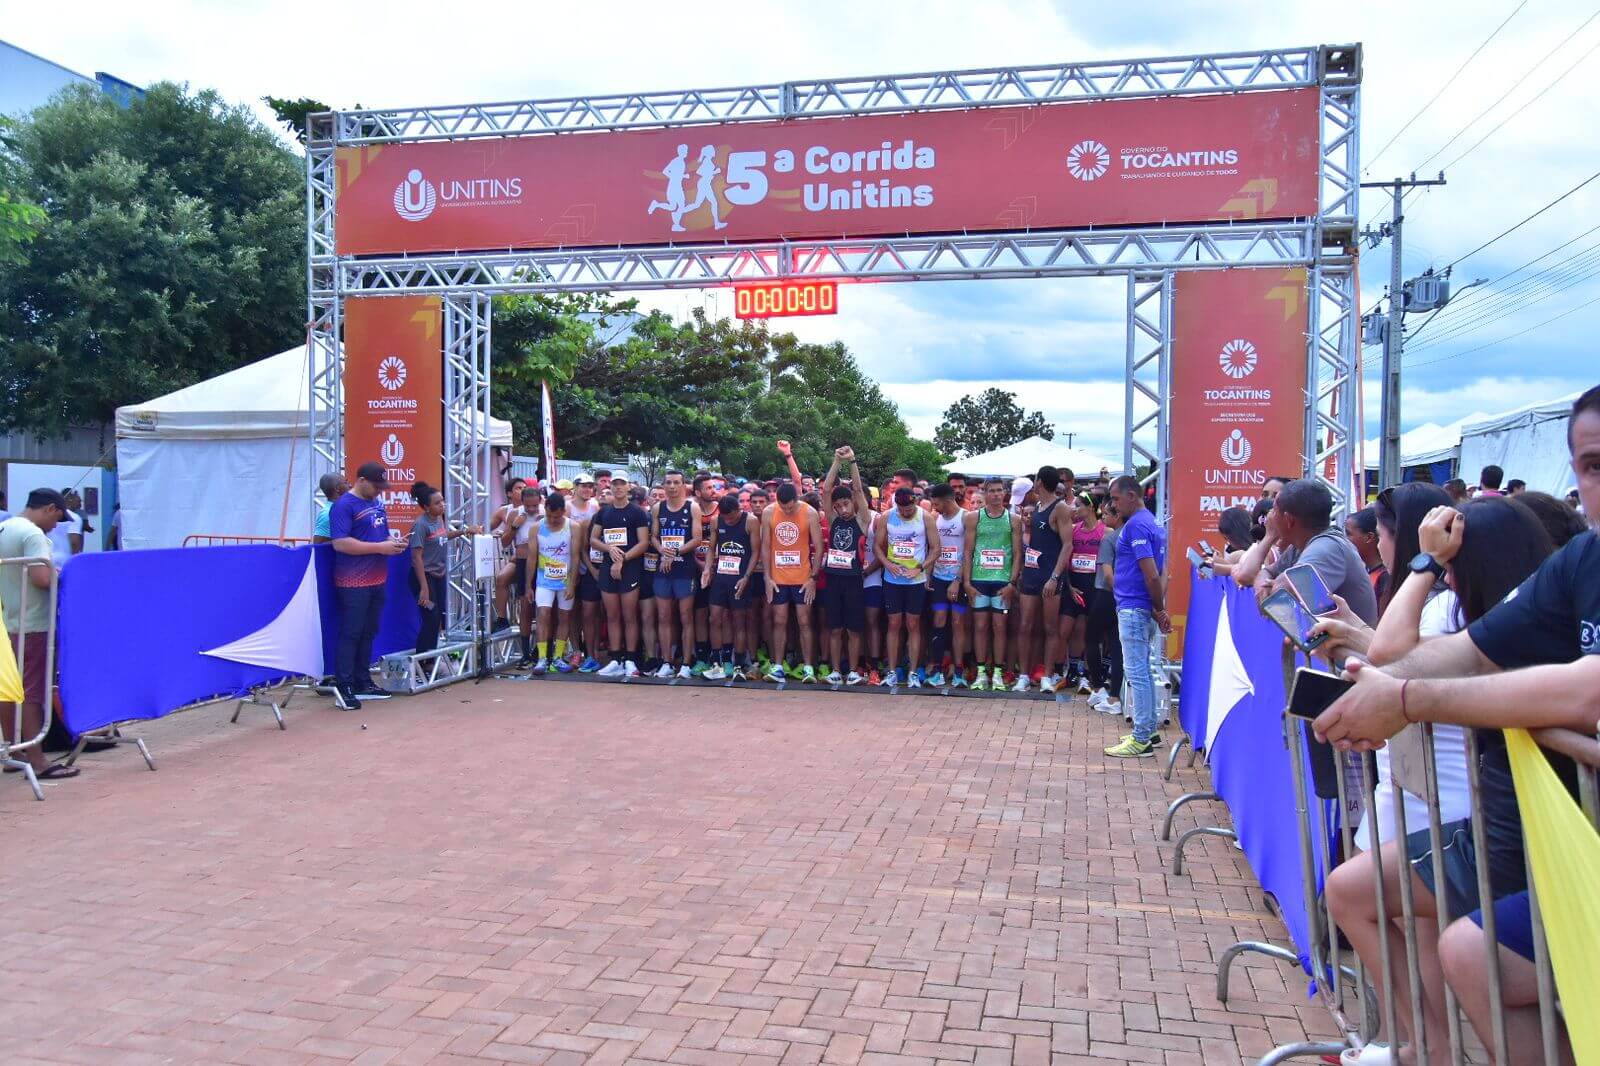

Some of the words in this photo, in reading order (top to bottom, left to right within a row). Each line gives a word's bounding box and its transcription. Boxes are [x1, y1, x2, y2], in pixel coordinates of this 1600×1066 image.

[804, 140, 935, 174] Corrida
[1121, 149, 1238, 169] TOCANTINS
[440, 177, 522, 200] UNITINS
[803, 179, 935, 212] Unitins
[738, 285, 833, 314] 00:00:00
[1204, 389, 1271, 400] TOCANTINS
[367, 399, 418, 409] TOCANTINS
[387, 468, 416, 481] ITINS
[1205, 469, 1266, 484] UNITINS
[1199, 495, 1258, 512] PALMA
